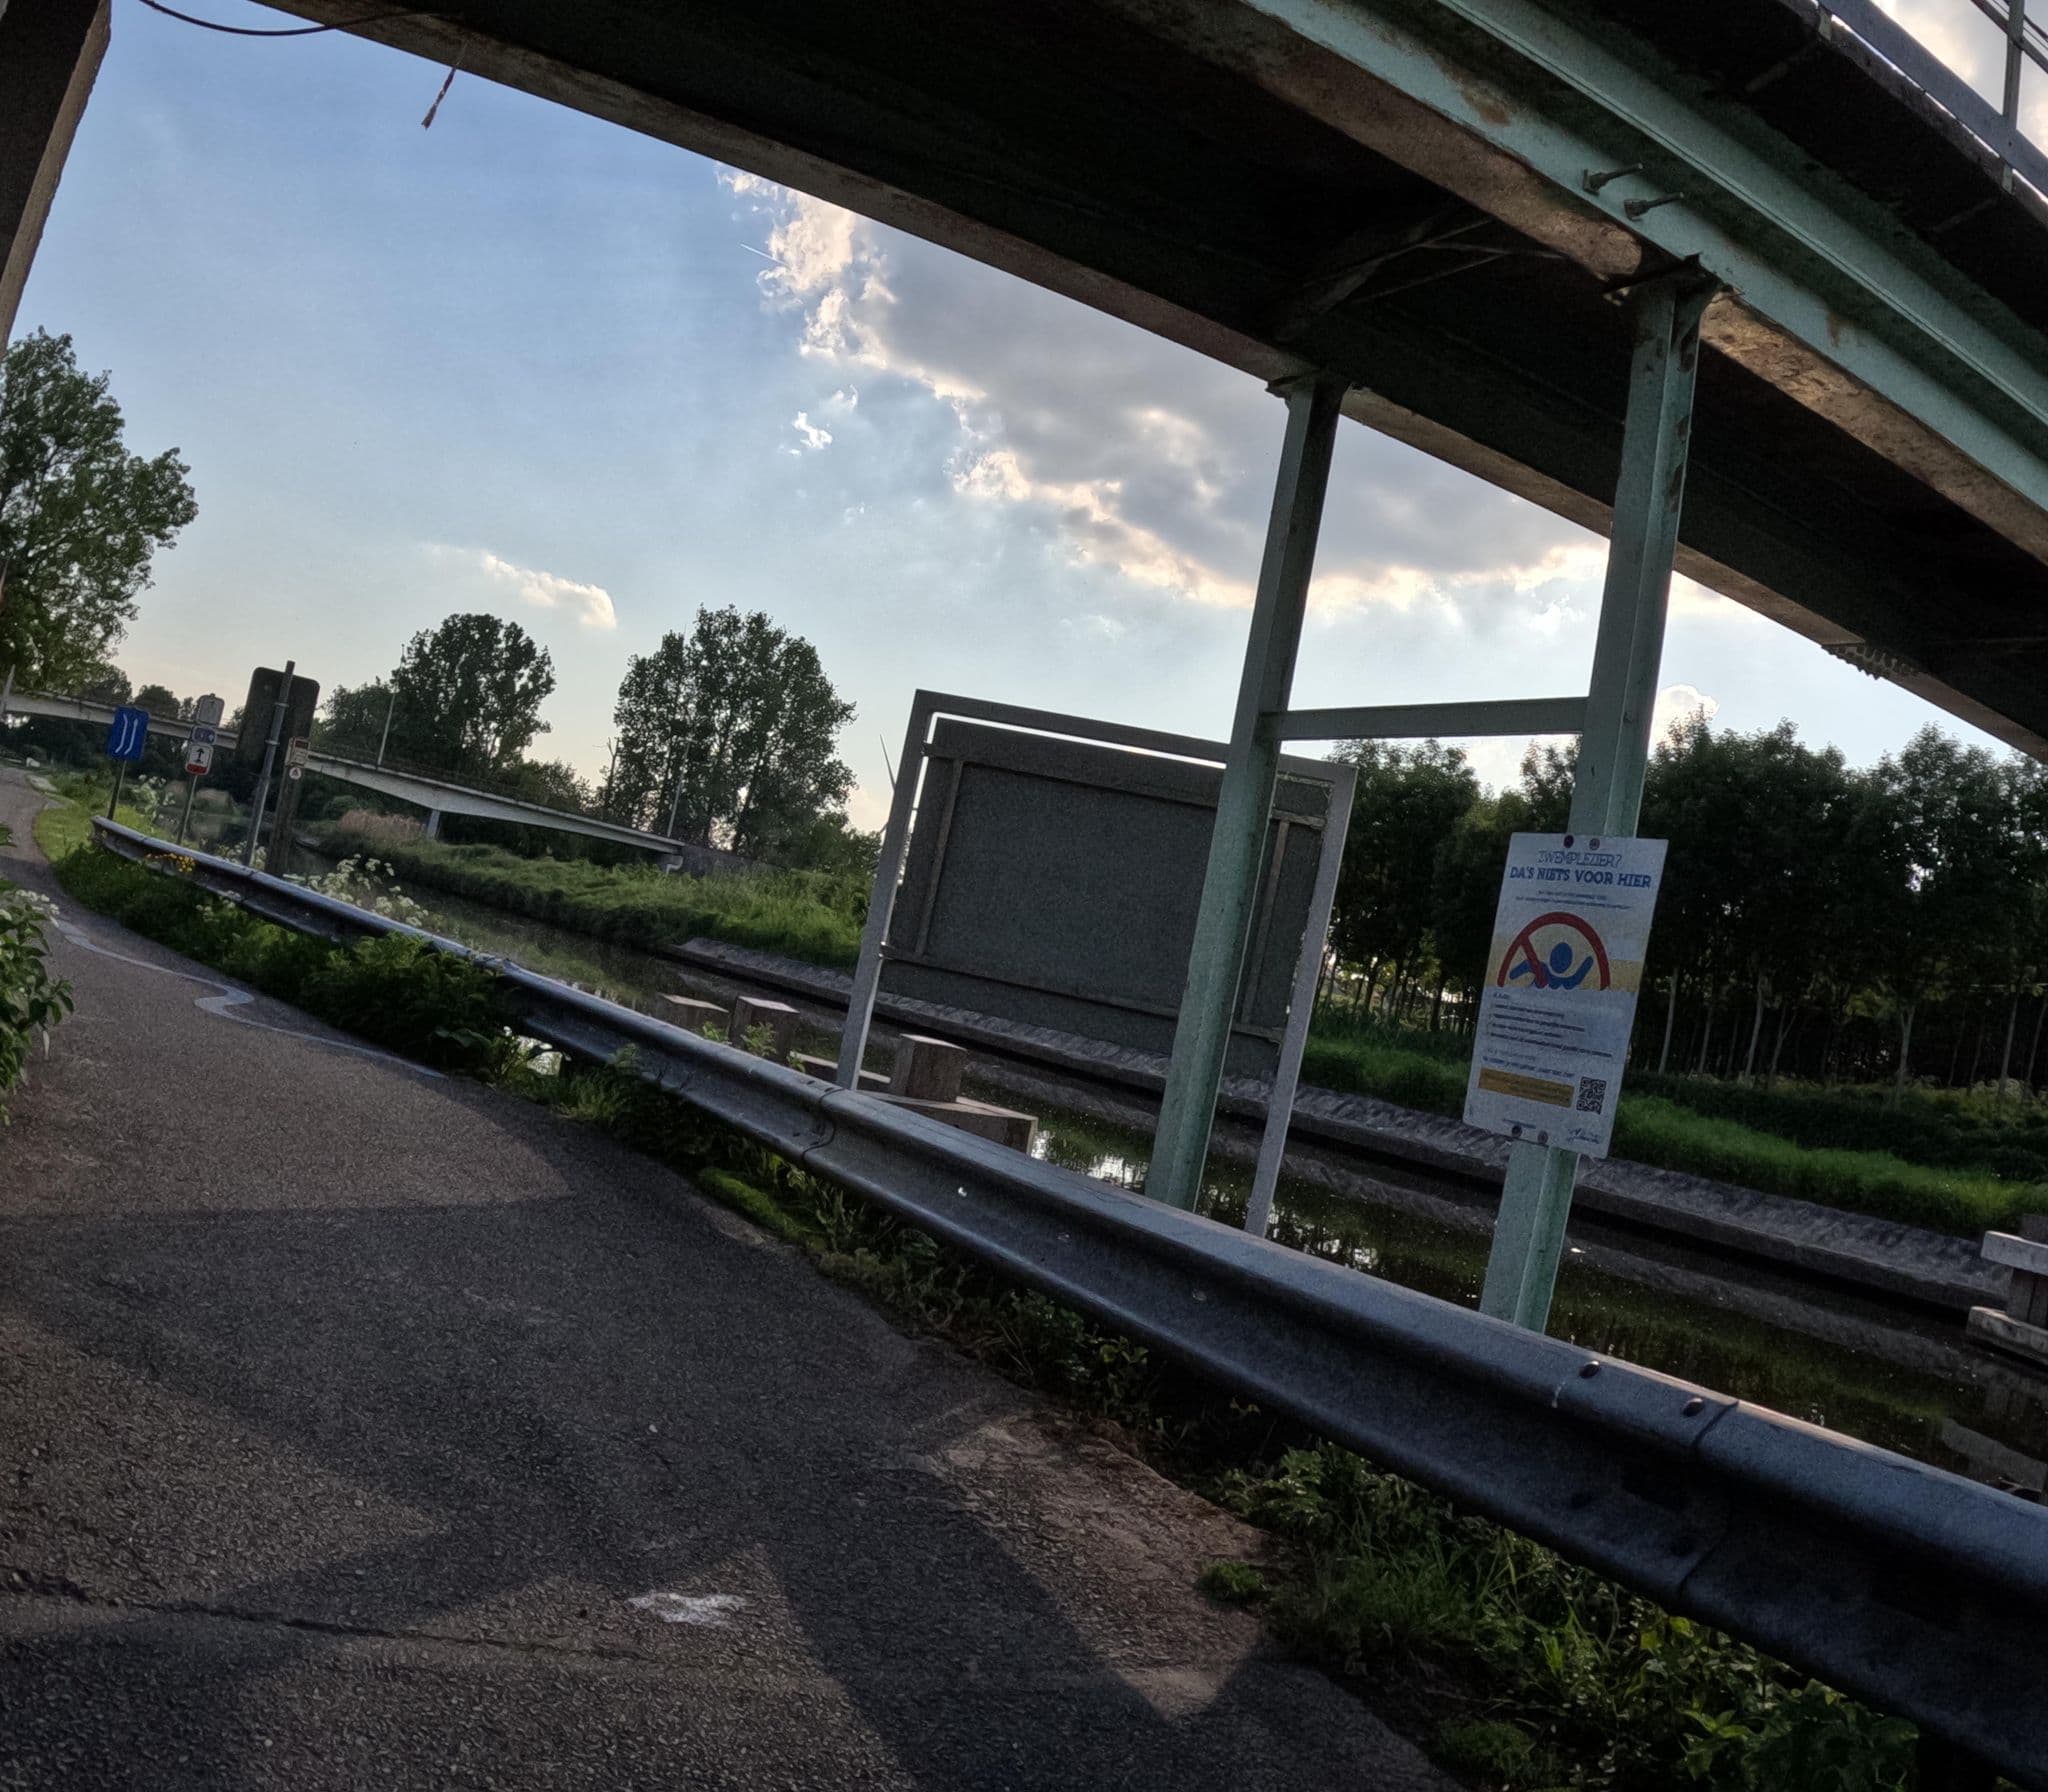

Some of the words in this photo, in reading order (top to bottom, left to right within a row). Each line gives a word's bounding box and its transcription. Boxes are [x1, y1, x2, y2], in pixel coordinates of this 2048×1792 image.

[1510, 866, 1535, 880] DA'S
[1536, 867, 1571, 882] NIETS
[1574, 870, 1614, 885] VOOR
[1616, 873, 1652, 889] HIER
